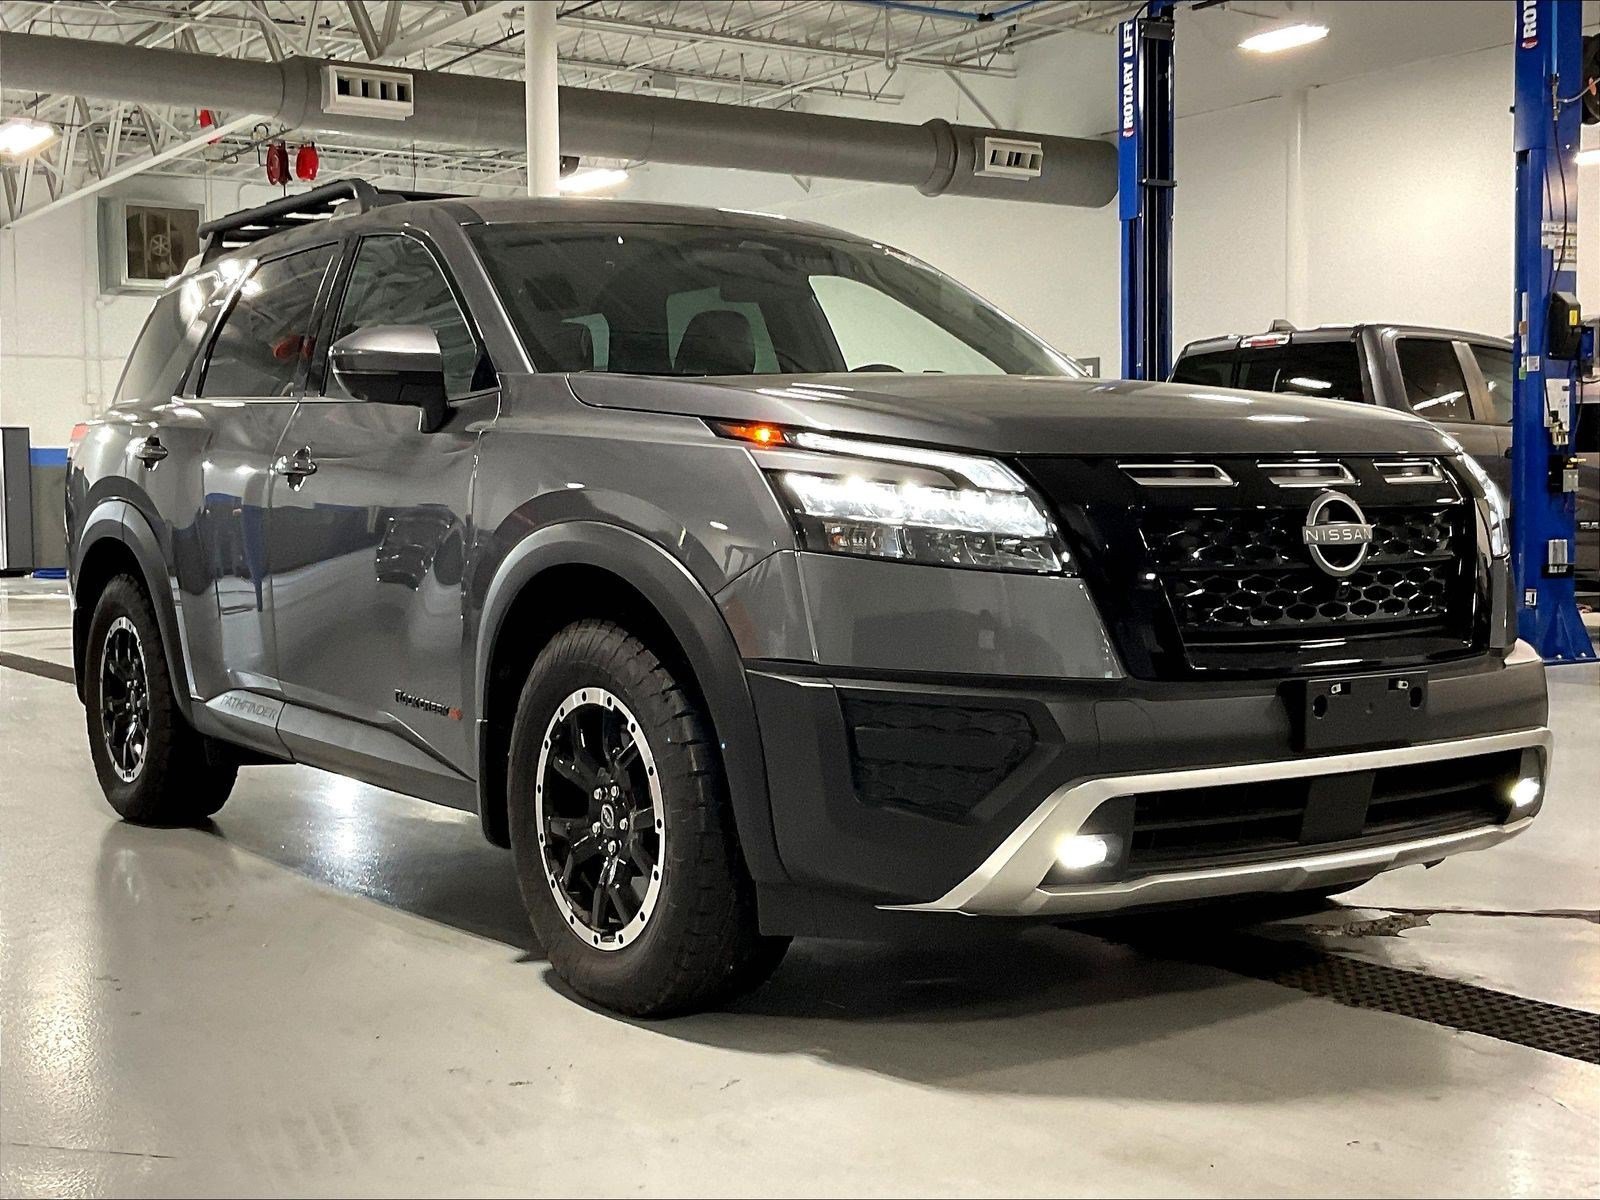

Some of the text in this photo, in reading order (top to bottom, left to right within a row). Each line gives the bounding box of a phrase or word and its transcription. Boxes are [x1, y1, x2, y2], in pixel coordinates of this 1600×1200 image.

[1123, 21, 1134, 128] ROTARY LIFT
[1305, 528, 1372, 541] NISSAN
[220, 695, 277, 720] PATHFINDER
